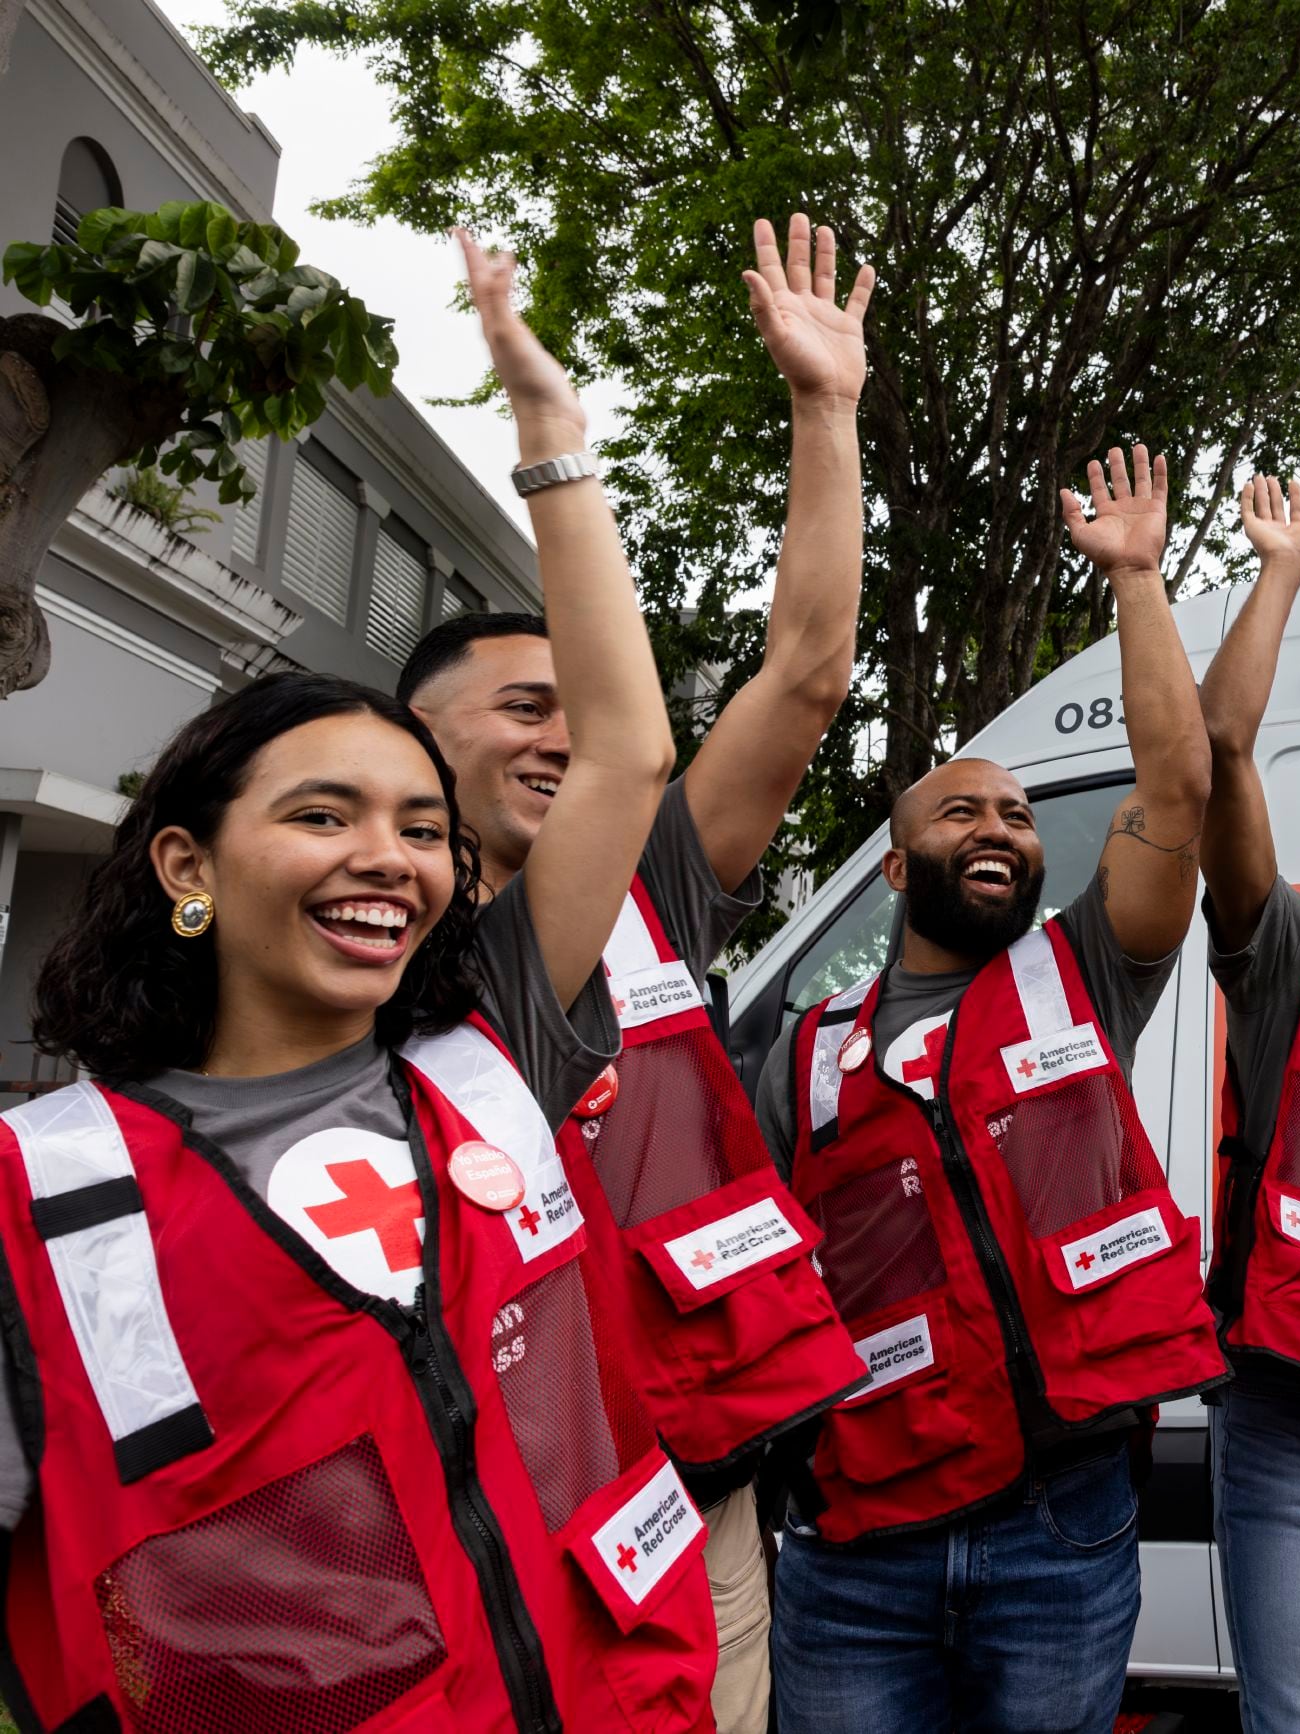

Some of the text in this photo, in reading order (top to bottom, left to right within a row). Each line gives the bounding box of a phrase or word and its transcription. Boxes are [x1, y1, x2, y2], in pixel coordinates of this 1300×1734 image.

[1054, 693, 1126, 735] 08
[628, 977, 688, 1000] American
[632, 988, 693, 1011] Red Cross
[1040, 1039, 1093, 1061] American
[1041, 1048, 1098, 1071] Red Cross
[454, 1149, 506, 1166] Yo hablo
[466, 1162, 513, 1181] Español
[546, 1203, 565, 1224] Red
[716, 1218, 779, 1250] American
[721, 1227, 787, 1260] Red Cross
[1100, 1225, 1157, 1252] American
[1100, 1234, 1161, 1262] Red Cross
[870, 1334, 922, 1363] American
[870, 1345, 925, 1374] Red Cross
[634, 1489, 680, 1542] American
[641, 1504, 687, 1557] Red Cross
